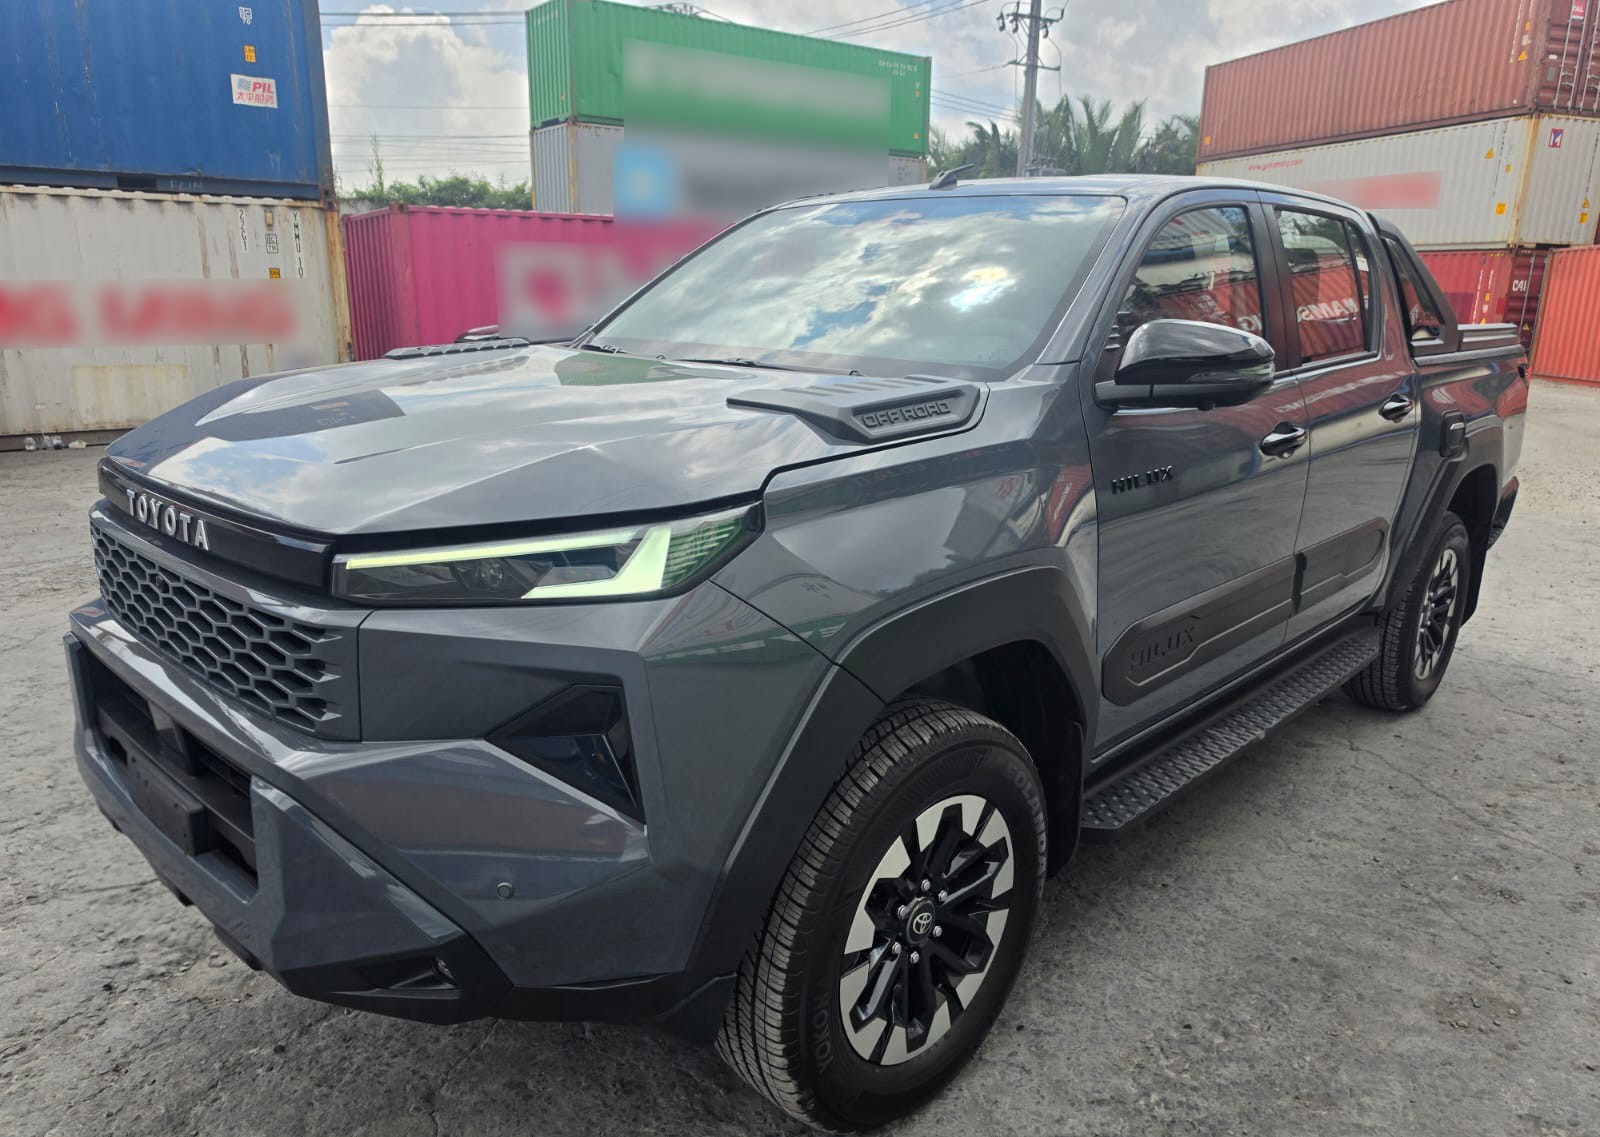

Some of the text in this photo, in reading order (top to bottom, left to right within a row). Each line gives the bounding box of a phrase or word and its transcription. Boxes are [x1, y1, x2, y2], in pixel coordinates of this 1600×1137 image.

[252, 82, 274, 94] PIL
[1111, 464, 1173, 496] HILUX
[126, 488, 209, 551] TOYOTA
[1128, 625, 1196, 674] HILUX
